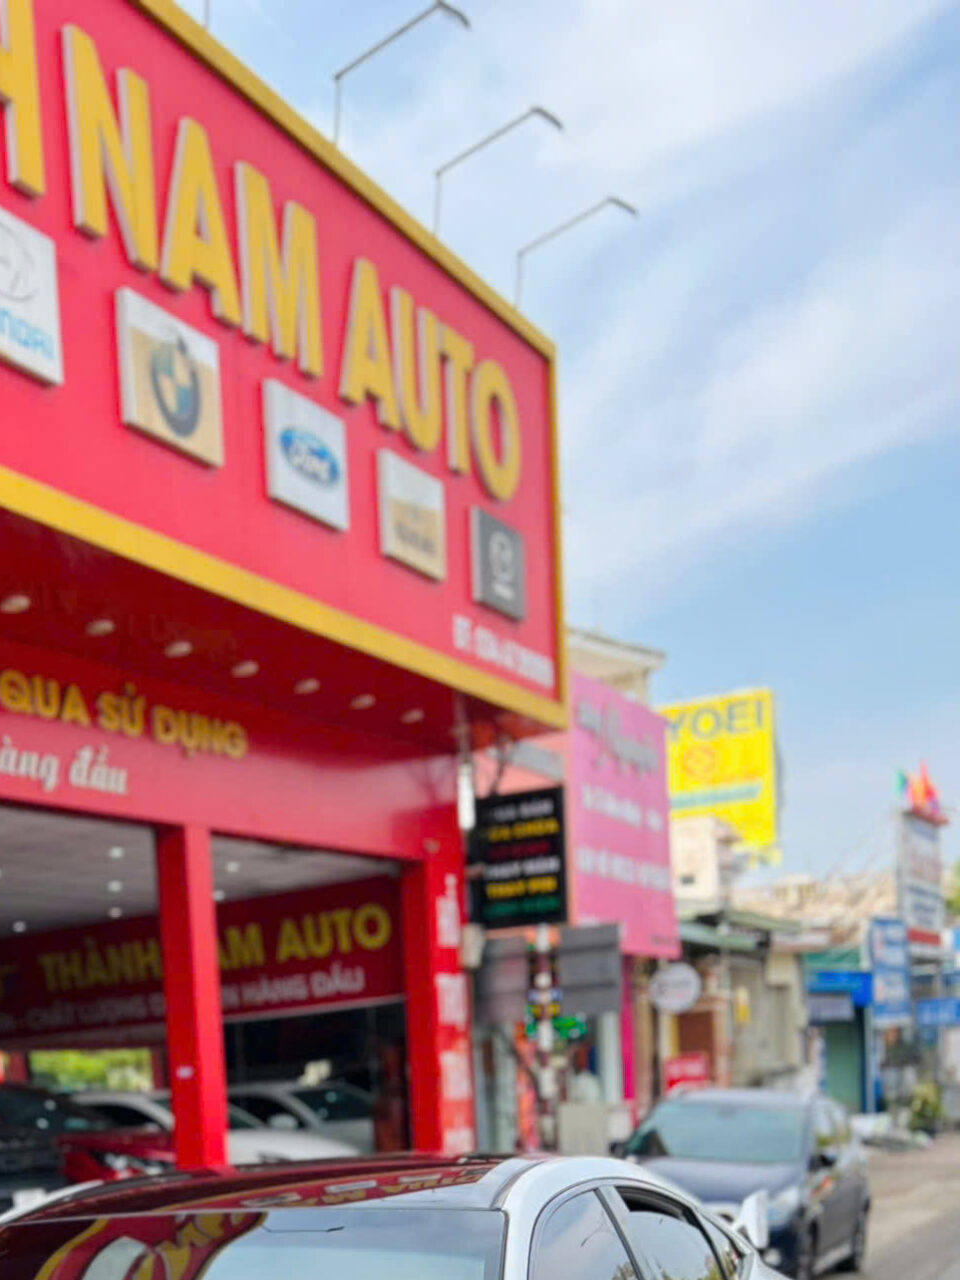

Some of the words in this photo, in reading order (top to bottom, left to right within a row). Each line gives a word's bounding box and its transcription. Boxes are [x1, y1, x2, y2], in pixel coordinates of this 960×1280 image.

[60, 22, 324, 381] NAM
[338, 255, 523, 503] AUTO
[96, 682, 146, 738] SỬ
[152, 706, 248, 760] DỤNG
[68, 744, 130, 796] đầu
[277, 903, 393, 964] AUTO
